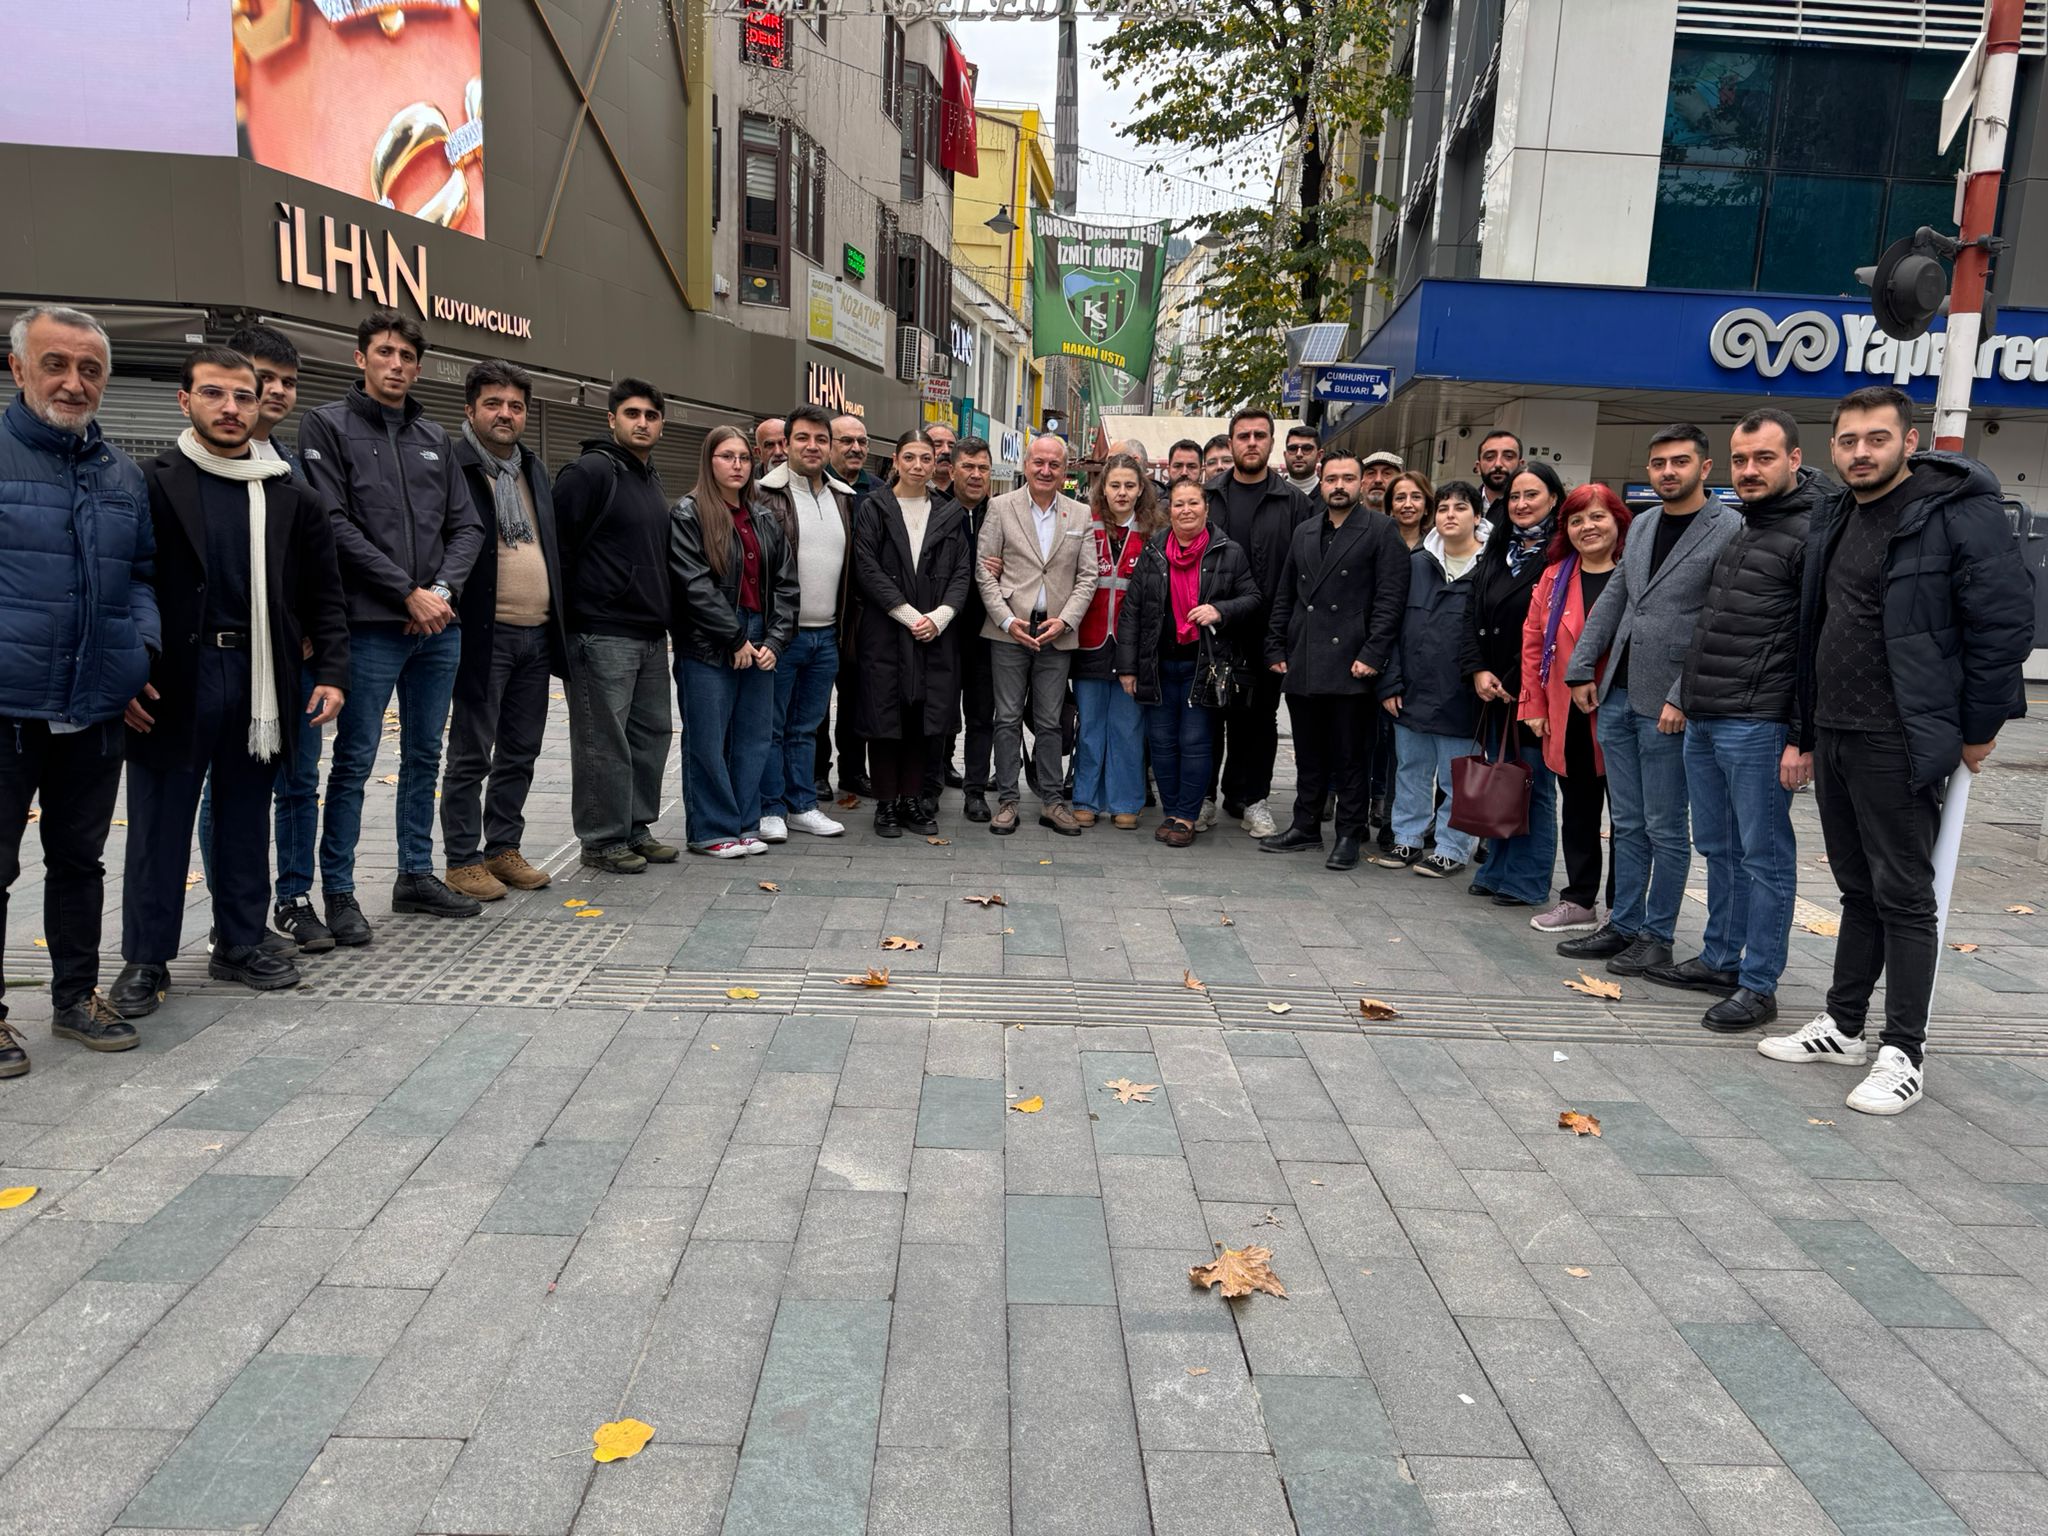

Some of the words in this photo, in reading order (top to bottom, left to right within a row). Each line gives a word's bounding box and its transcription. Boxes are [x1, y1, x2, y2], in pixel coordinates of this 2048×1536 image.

[748, 27, 781, 48] DERİ
[277, 201, 429, 321] İLHAN
[433, 295, 533, 339] KUYUMCULUK
[1057, 241, 1092, 265] İZMİT
[1094, 243, 1144, 272] KÖRFEZİ
[839, 290, 882, 332] KOZATUR
[1062, 341, 1099, 360] HAKAN
[1100, 349, 1126, 369] USTA
[808, 360, 846, 416] İLHAN
[929, 379, 951, 388] KRAL
[1326, 371, 1381, 384] CUMHURİYET
[1333, 384, 1370, 396] BULVARI
